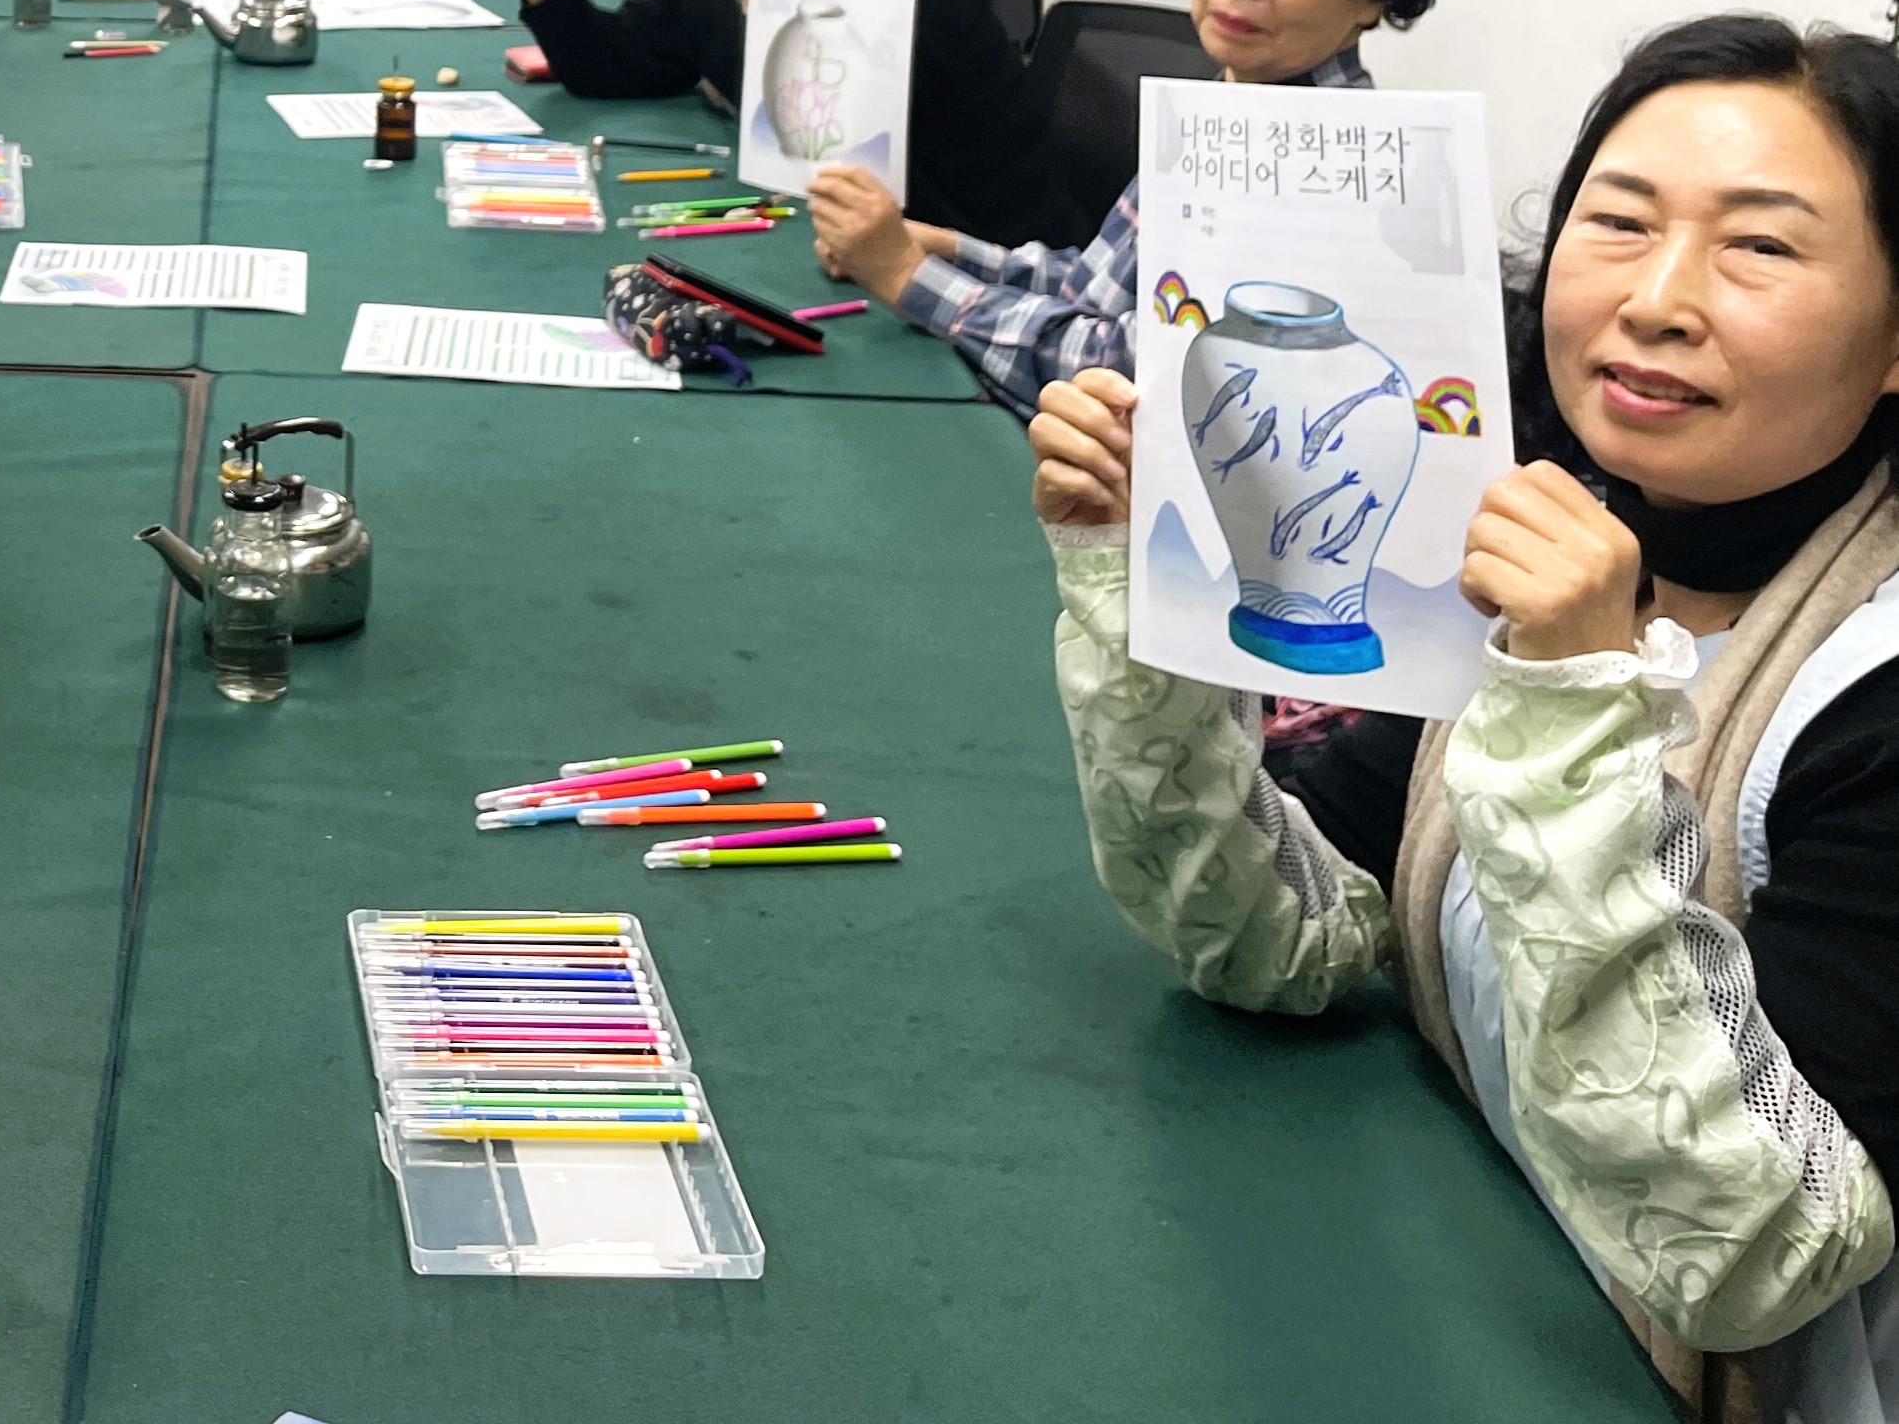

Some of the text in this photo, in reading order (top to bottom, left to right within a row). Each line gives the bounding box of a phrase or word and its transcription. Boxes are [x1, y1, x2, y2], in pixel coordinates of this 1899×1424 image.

[1181, 114, 1411, 164] 나만의 청화백자
[1182, 152, 1406, 205] 아이디어 스케치
